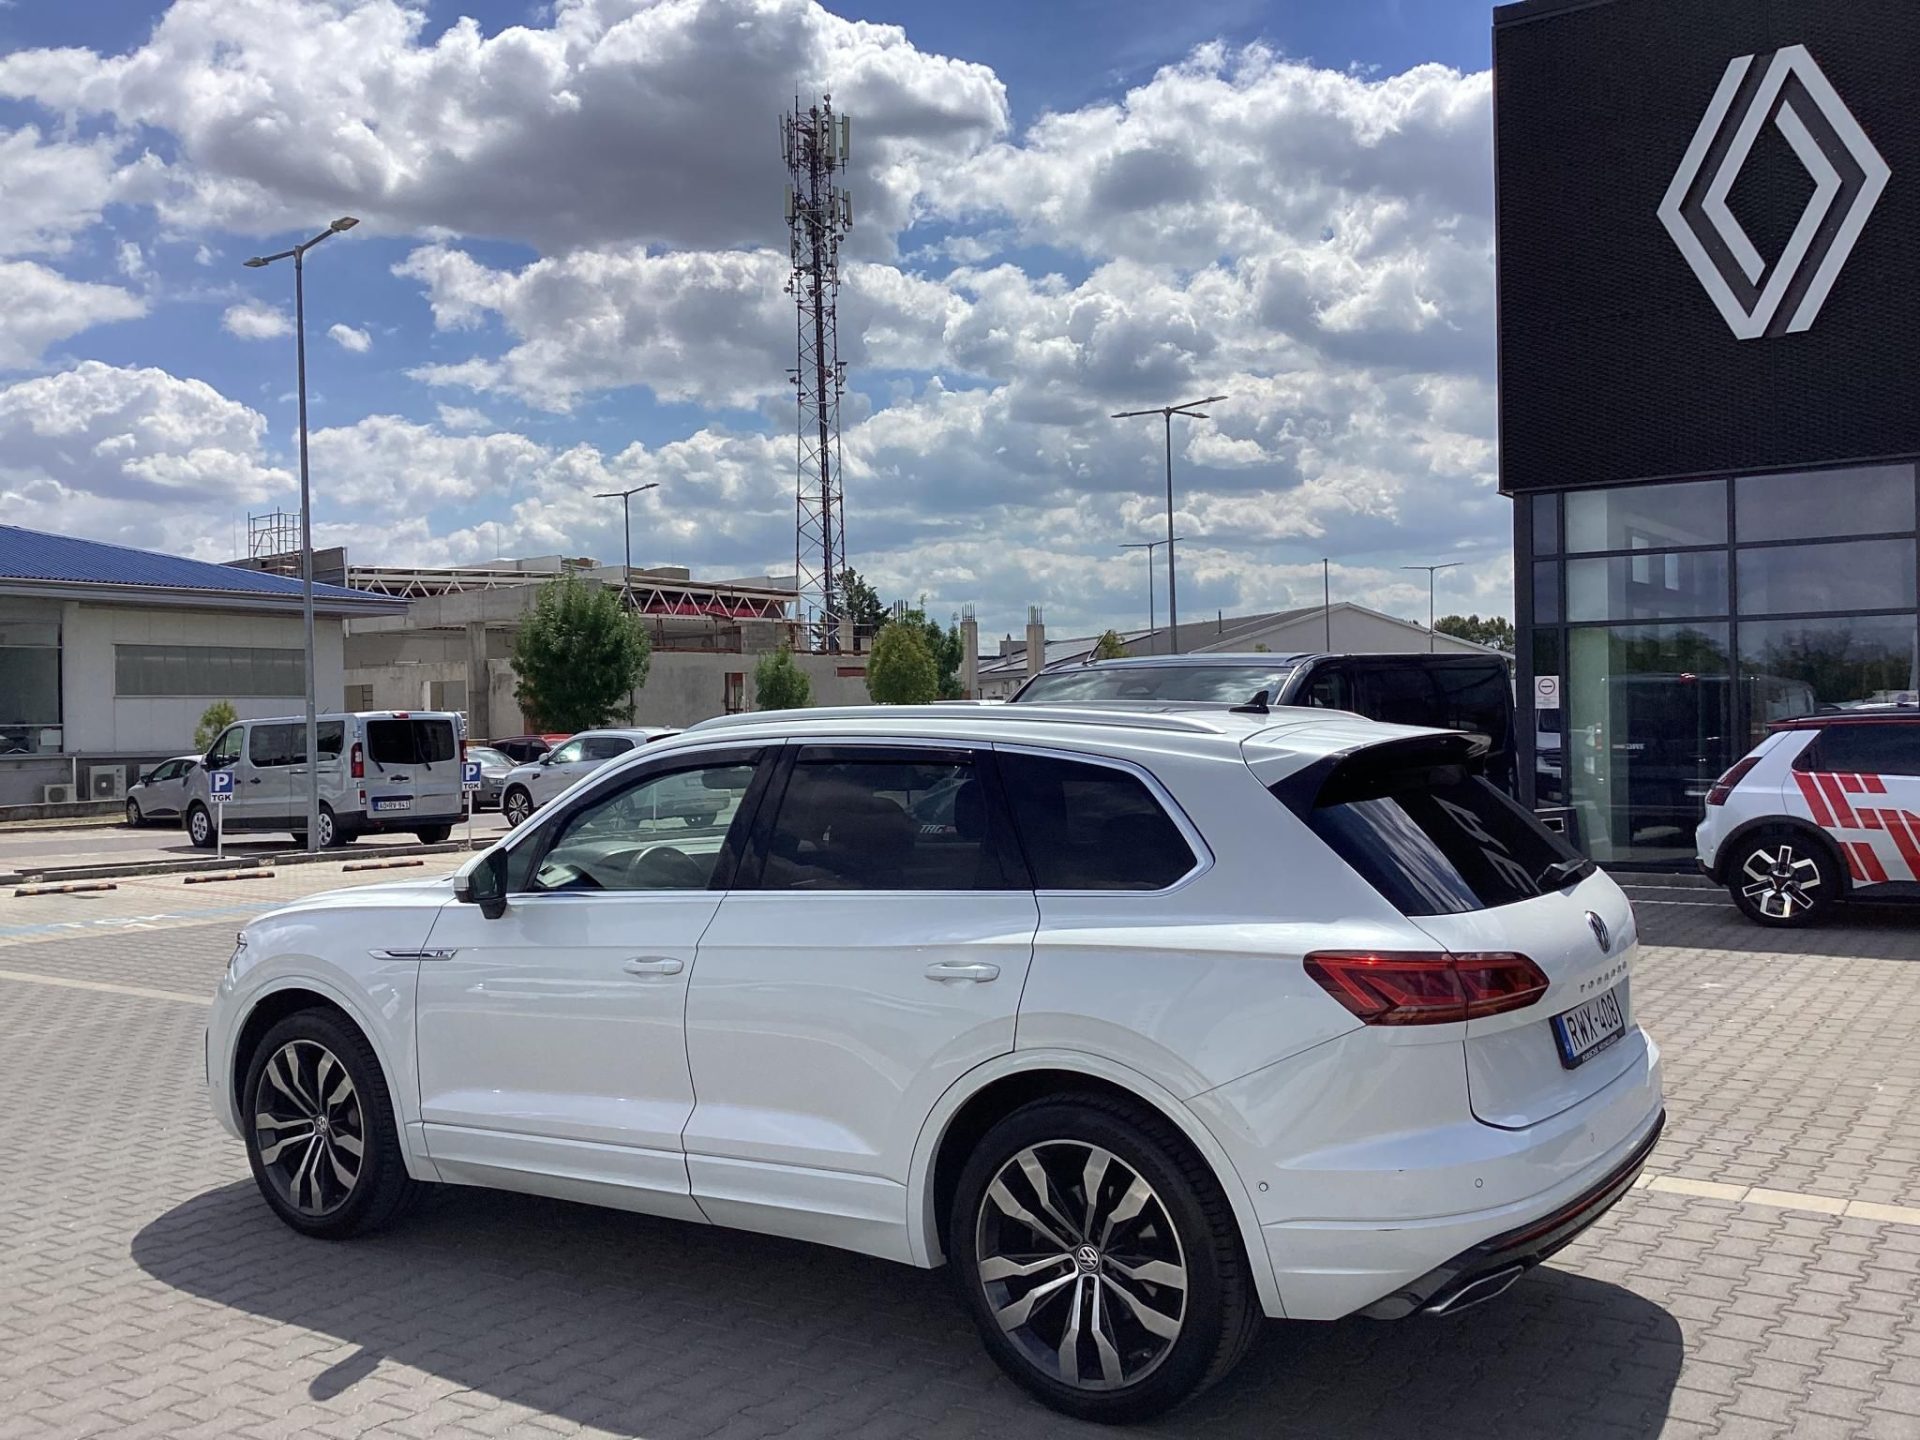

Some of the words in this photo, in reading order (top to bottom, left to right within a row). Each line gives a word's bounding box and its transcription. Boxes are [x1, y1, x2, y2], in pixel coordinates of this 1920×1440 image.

[465, 764, 478, 780] P
[215, 773, 229, 791] P
[1566, 994, 1619, 1051] RWX-408
